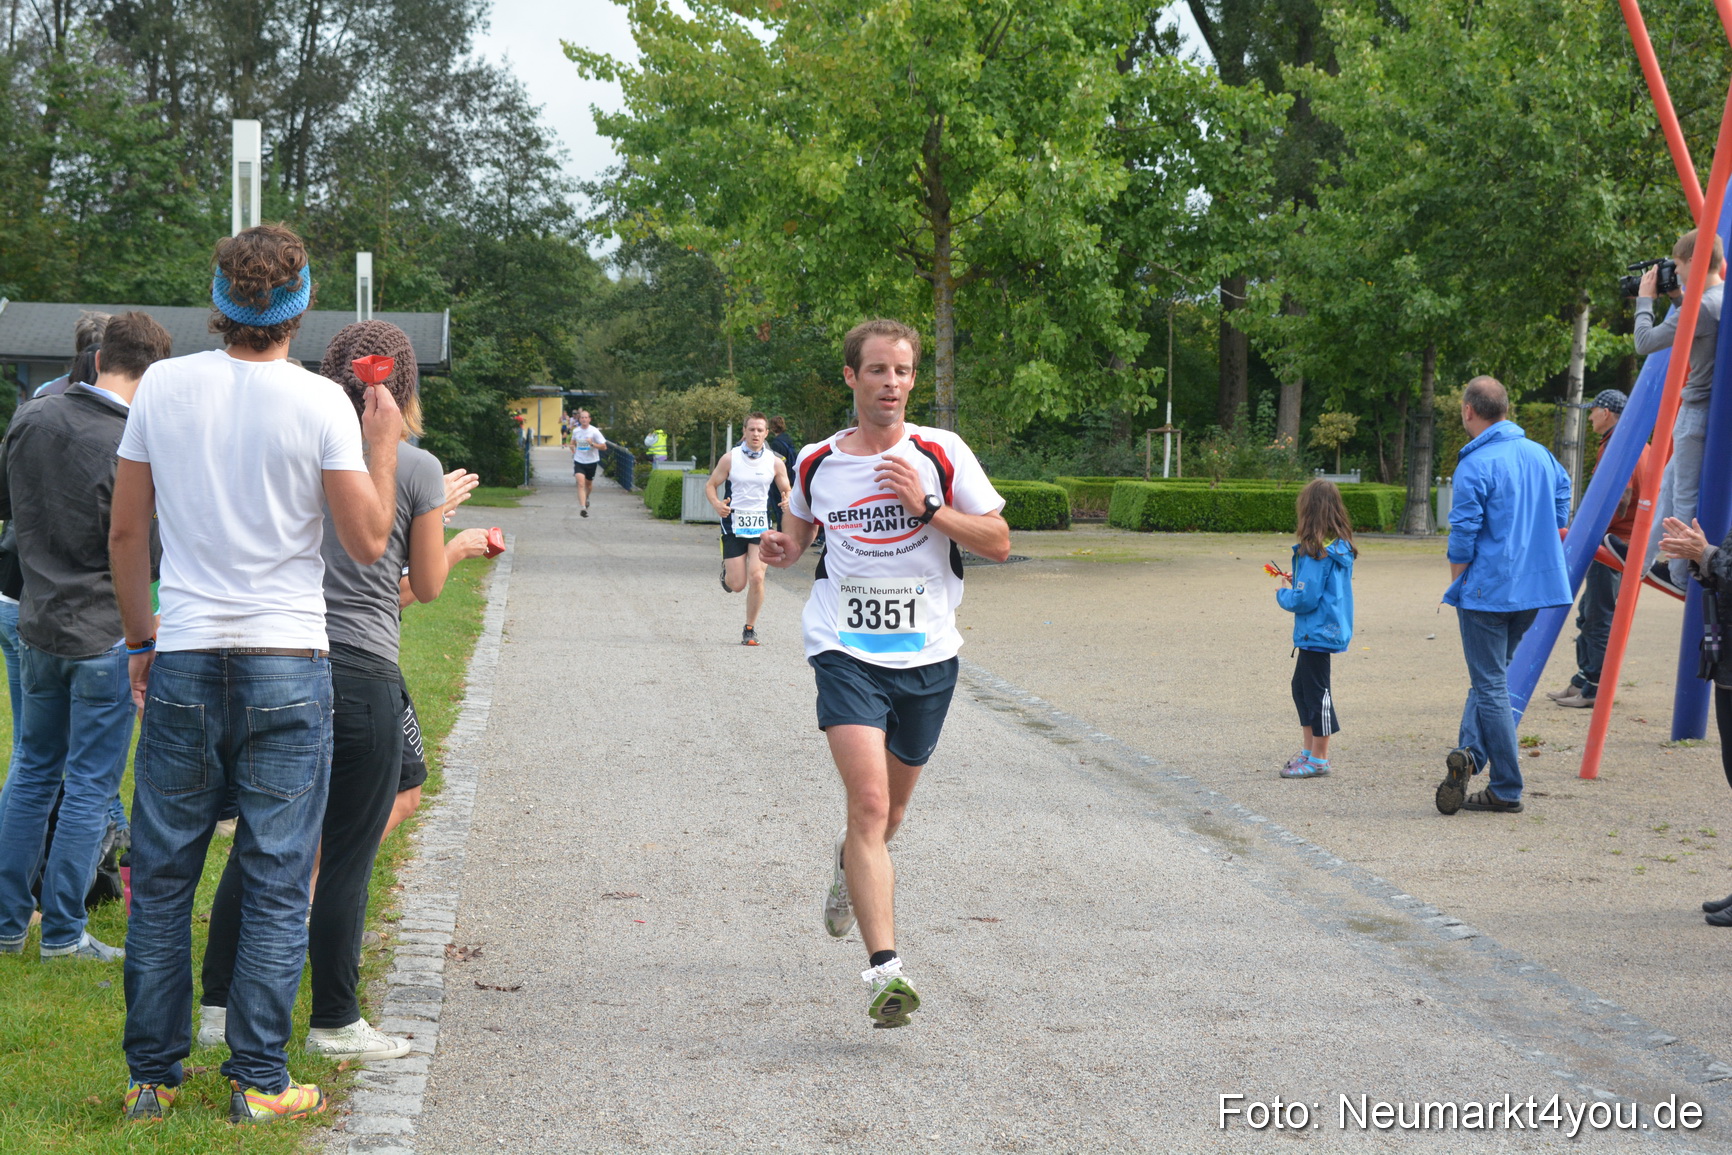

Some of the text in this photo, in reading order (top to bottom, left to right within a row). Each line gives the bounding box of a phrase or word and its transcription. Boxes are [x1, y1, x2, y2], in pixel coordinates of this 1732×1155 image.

[738, 516, 765, 528] 3376
[828, 505, 904, 523] GERHART
[841, 534, 929, 558] Das sportliche Autohaus
[840, 584, 913, 595] PARTL Neumarkt
[847, 598, 916, 630] 3351
